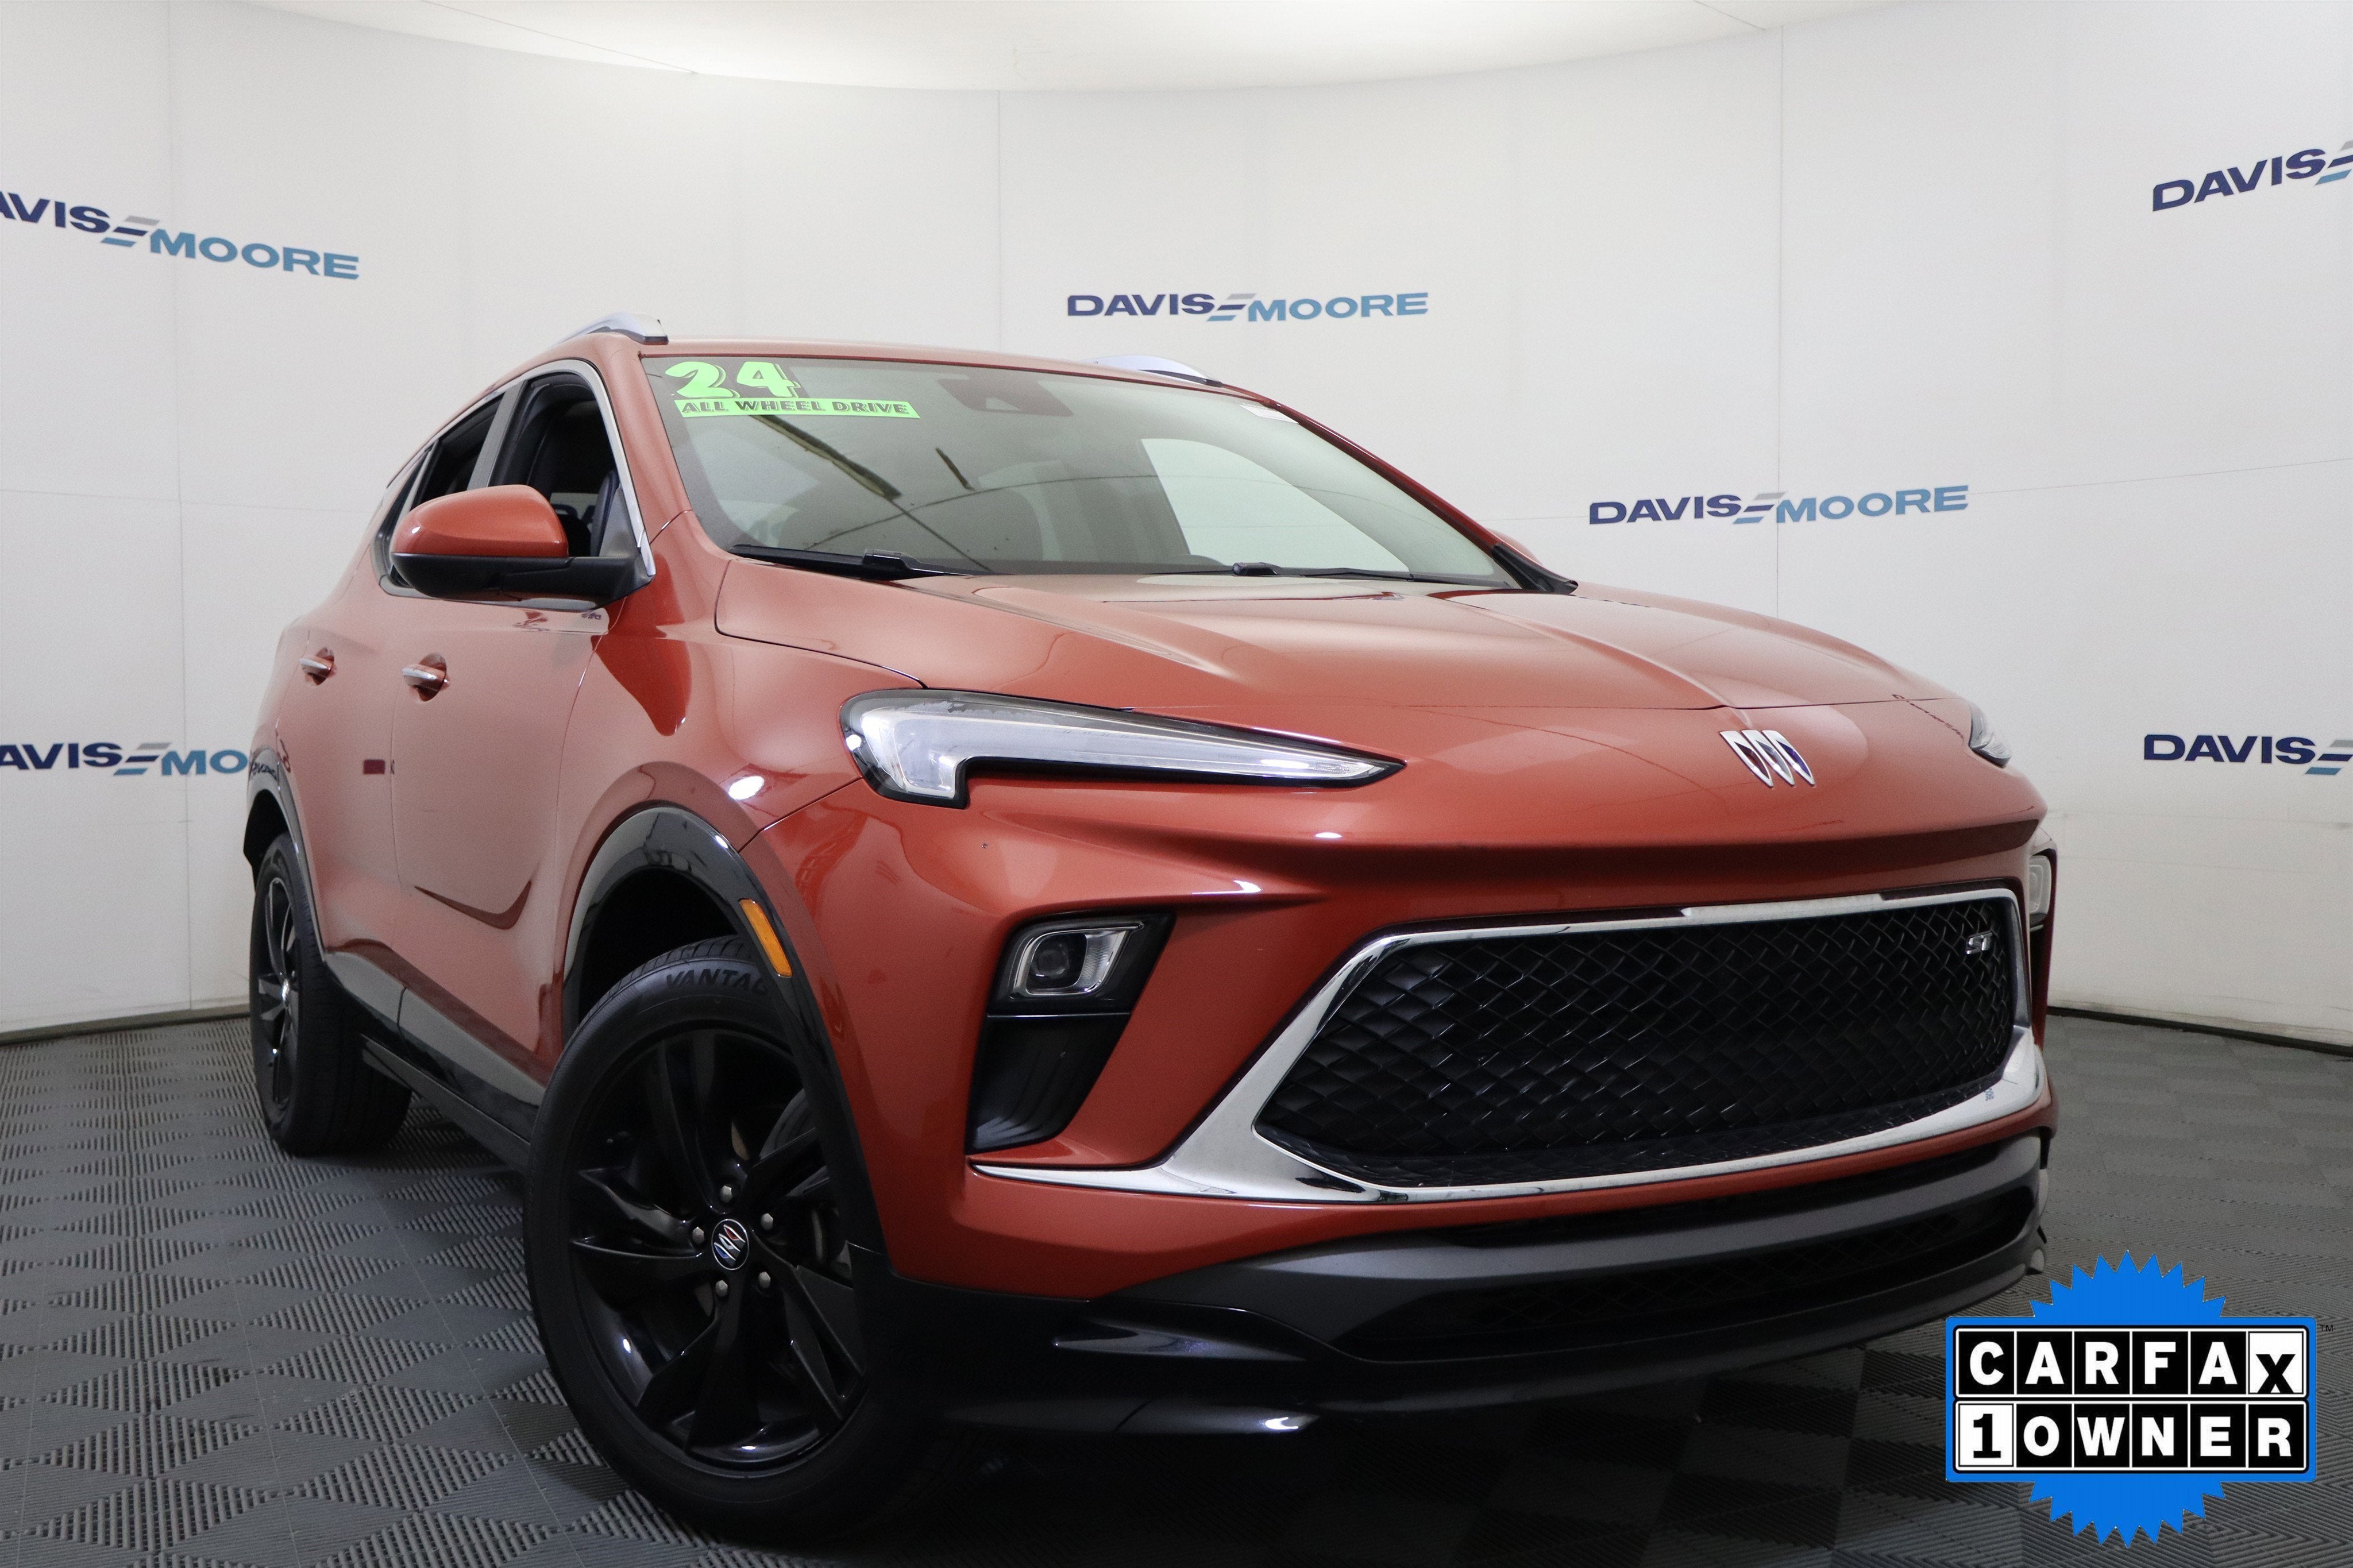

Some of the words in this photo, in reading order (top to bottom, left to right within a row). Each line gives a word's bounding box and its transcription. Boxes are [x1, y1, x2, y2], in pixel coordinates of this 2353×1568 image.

[2153, 148, 2327, 211] DAVIS
[150, 228, 360, 280] MOORE
[1067, 293, 1215, 316] DAVIS
[1247, 292, 1429, 322] MOORE
[665, 361, 801, 399] 24
[681, 401, 728, 414] ALL
[734, 400, 826, 413] WHEEL
[831, 401, 909, 415] DRIVE
[1589, 494, 1741, 525] DAVIS
[1775, 485, 1969, 524] MOORE
[2144, 733, 2316, 764] DAVIS
